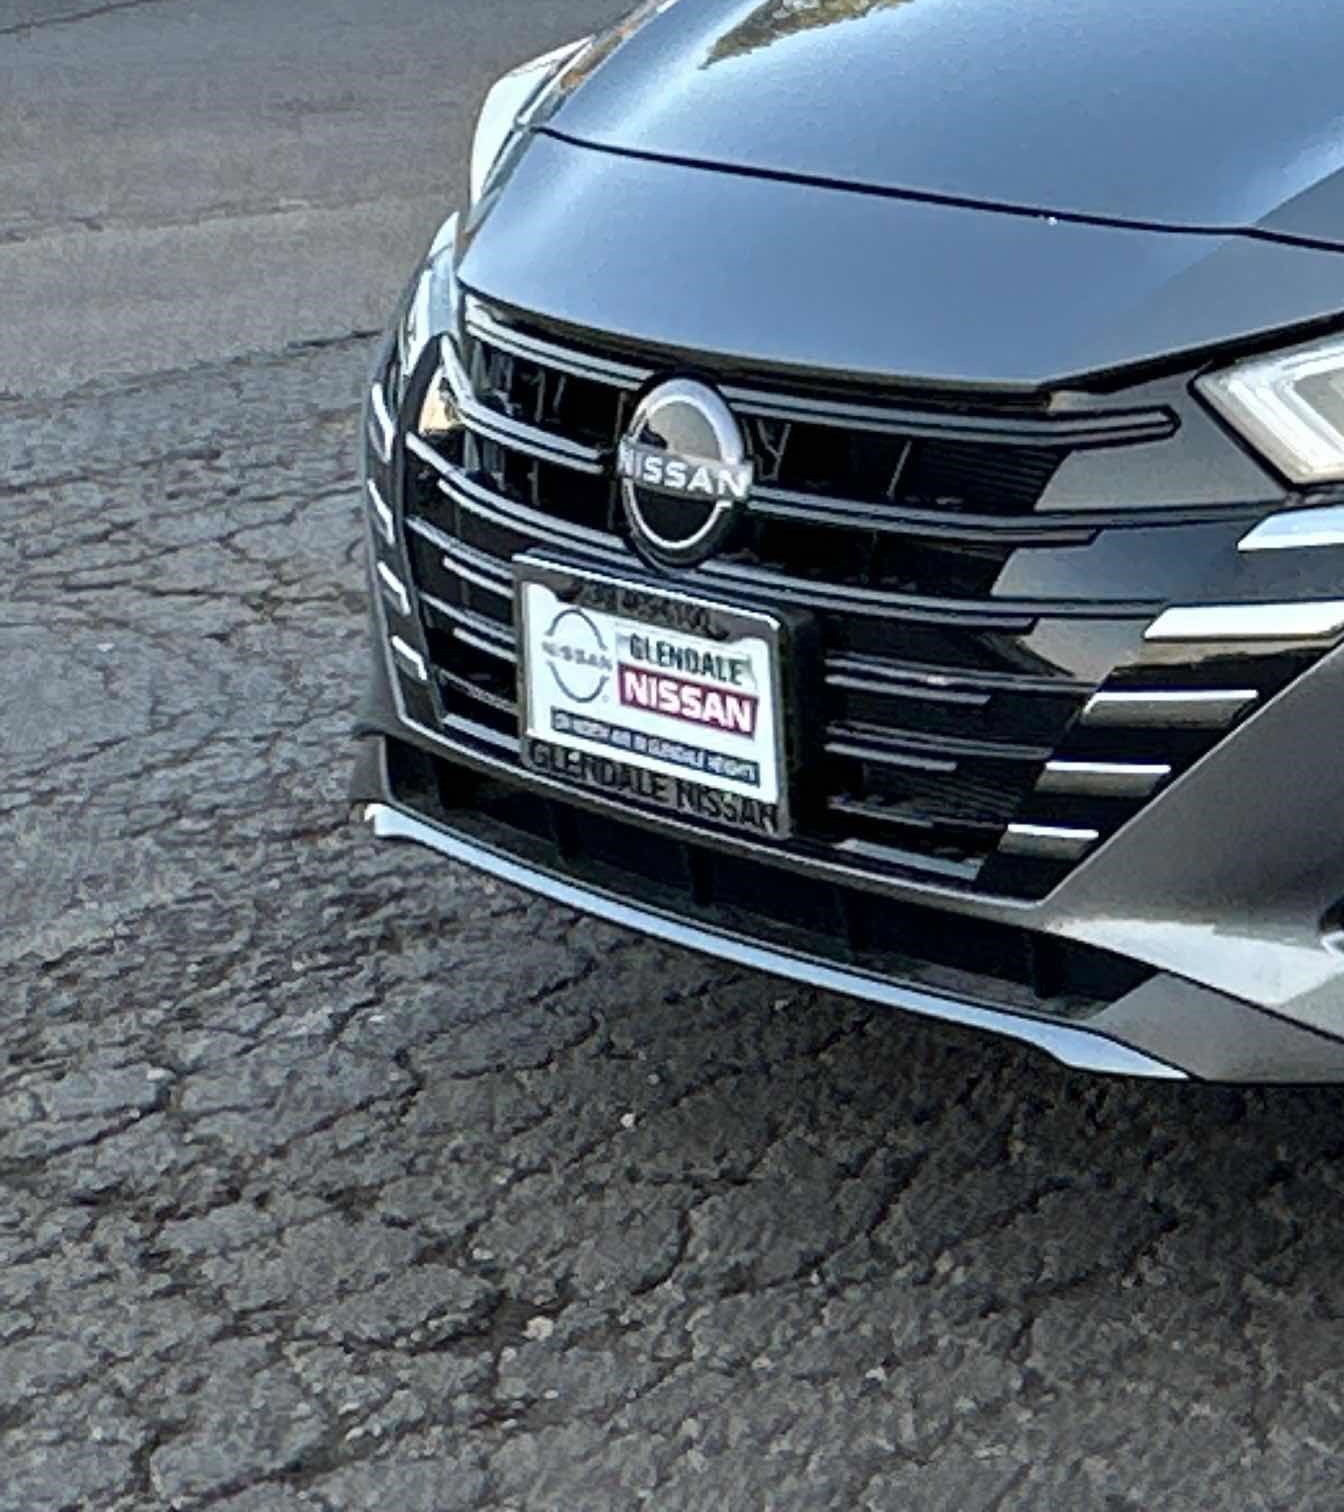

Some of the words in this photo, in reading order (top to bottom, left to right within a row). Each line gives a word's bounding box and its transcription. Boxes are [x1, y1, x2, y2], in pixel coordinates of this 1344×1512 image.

[617, 441, 748, 498] NISSAN
[629, 633, 744, 686] GLENDALE
[622, 670, 752, 733] NISSAN
[528, 739, 671, 803] GLENDALE
[675, 783, 779, 834] NISSAN
